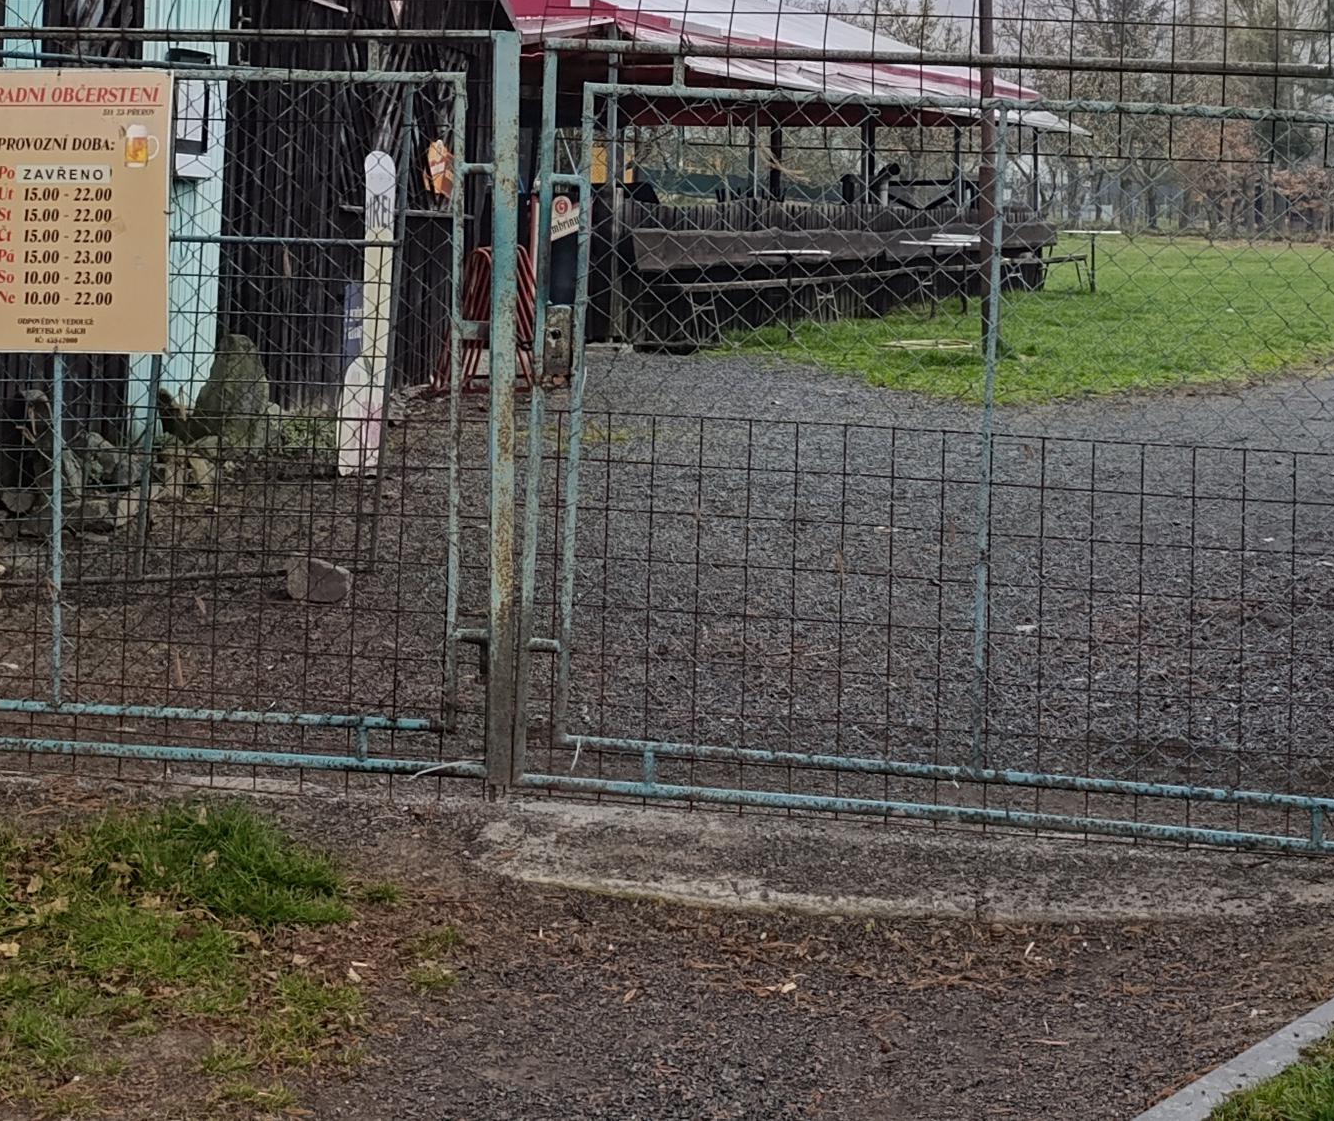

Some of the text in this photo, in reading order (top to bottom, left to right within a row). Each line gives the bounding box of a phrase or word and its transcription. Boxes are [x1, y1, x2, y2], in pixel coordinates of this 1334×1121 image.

[51, 84, 161, 103] OBČERSTENÍ
[72, 137, 116, 151] DOBA:
[23, 167, 104, 180] ZAVŘENO
[23, 188, 59, 202] 15.00
[73, 188, 112, 202] 22.00
[23, 209, 59, 223] 15.00
[73, 209, 112, 223] 22.00
[23, 229, 59, 243] 15.00
[73, 229, 112, 243] 22.00
[23, 250, 59, 264] 15.00
[73, 250, 112, 264] 23.00
[23, 271, 59, 285] 10.00
[73, 271, 112, 285] 23.00
[23, 292, 59, 306] 10.00
[73, 292, 112, 306] 22.00
